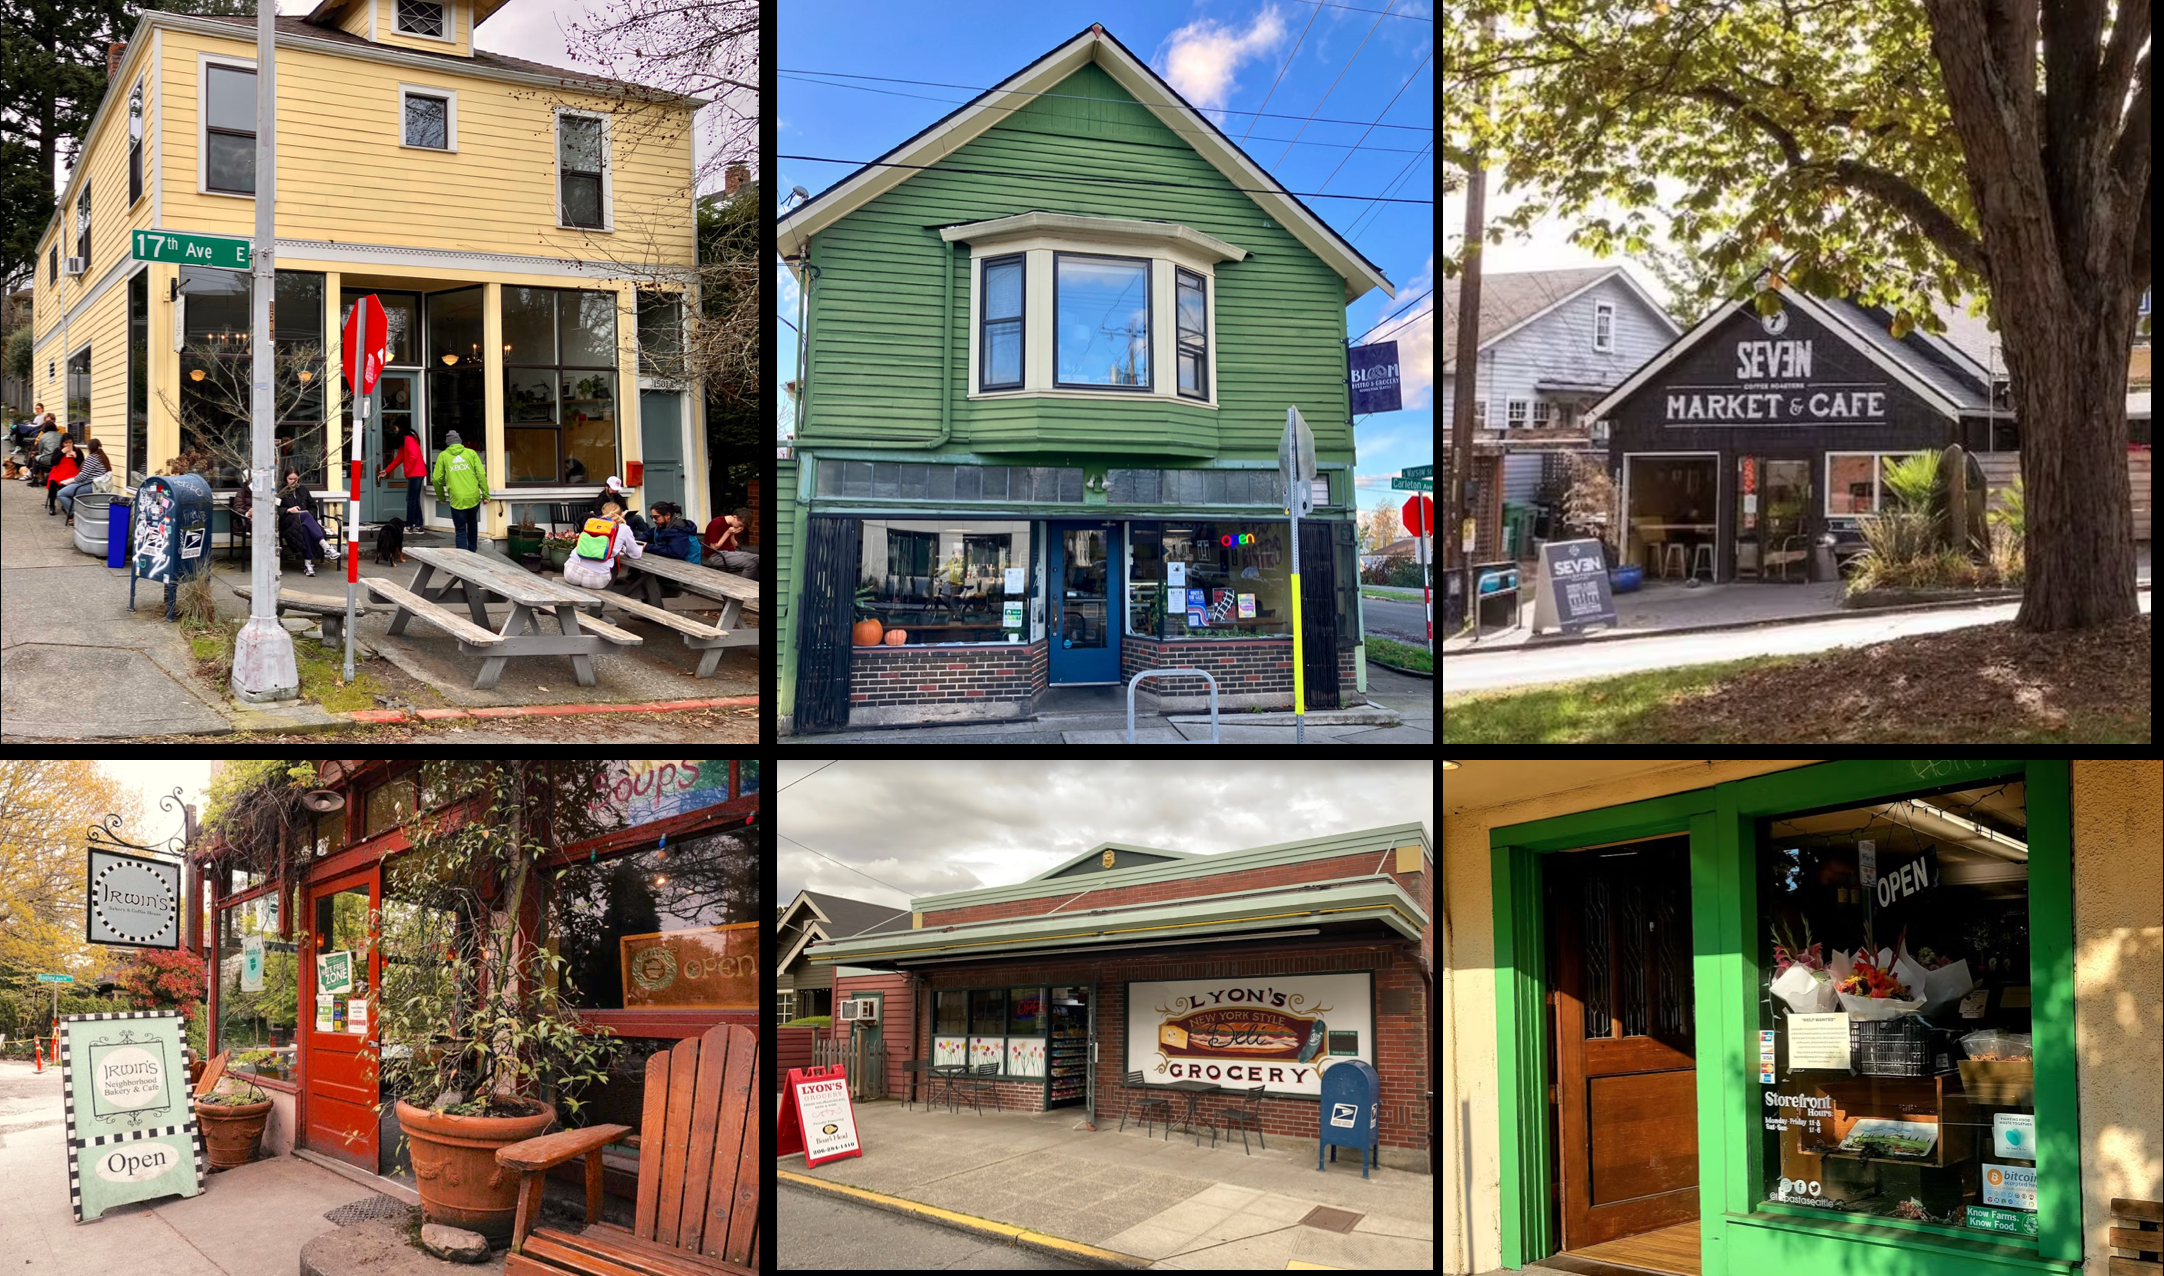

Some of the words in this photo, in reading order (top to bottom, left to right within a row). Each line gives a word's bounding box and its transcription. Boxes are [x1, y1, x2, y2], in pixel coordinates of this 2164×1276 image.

[137, 234, 178, 258] 17th
[185, 242, 212, 259] Ave
[236, 246, 246, 262] E
[1737, 340, 1812, 379] SEVEN
[1351, 364, 1399, 383] BLOOM
[1352, 381, 1370, 390] BISTRO
[1375, 377, 1399, 387] GROCERY
[1666, 394, 1784, 420] MARKET
[1789, 398, 1804, 416] &
[1809, 392, 1886, 418] CAFE
[449, 464, 471, 472] XBOX
[1393, 478, 1422, 489] Carleton
[1221, 533, 1255, 549] open
[1554, 556, 1602, 576] SEVEN
[1877, 856, 1929, 908] OPEN
[108, 905, 126, 913] Bakery
[334, 961, 345, 971] FREE
[325, 968, 348, 985] ZONE
[1188, 987, 1287, 1010] LYON'S
[1189, 1013, 1216, 1028] NEW
[1219, 1011, 1250, 1021] YORK
[1252, 1012, 1286, 1027] STYLE
[1207, 1022, 1267, 1049] Deli
[1169, 1063, 1310, 1084] GROCERY
[105, 1077, 157, 1089] Neighborhood
[801, 1082, 843, 1095] LYON'S
[104, 1088, 131, 1096] Bakery
[804, 1091, 842, 1102] GROCERY
[1764, 1091, 1832, 1109] Storefront
[107, 1151, 166, 1176] Open
[1967, 1207, 1989, 1218] Know
[1992, 1210, 2019, 1222] Farms.
[1969, 1217, 1992, 1228] Know
[1994, 1220, 2017, 1231] Food.
